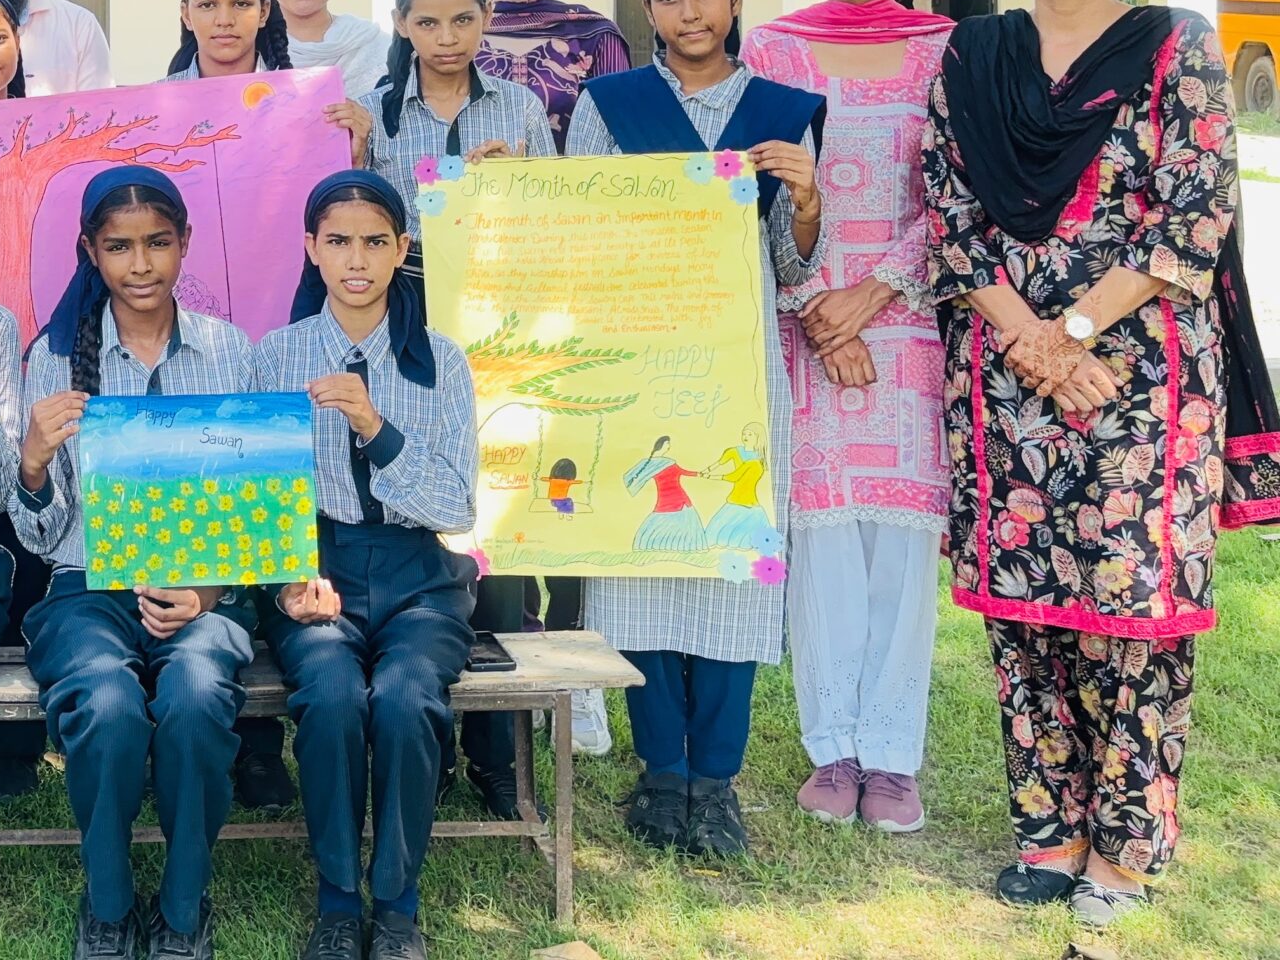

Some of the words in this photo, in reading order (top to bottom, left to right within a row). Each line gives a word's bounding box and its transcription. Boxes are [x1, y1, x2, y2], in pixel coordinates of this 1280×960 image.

[461, 171, 500, 197] The
[506, 171, 574, 202] Month
[576, 171, 604, 200] of
[134, 400, 177, 429] Happy
[199, 427, 244, 459] Sawan
[480, 444, 527, 465] HAPPY
[488, 470, 529, 486] SAWAN
